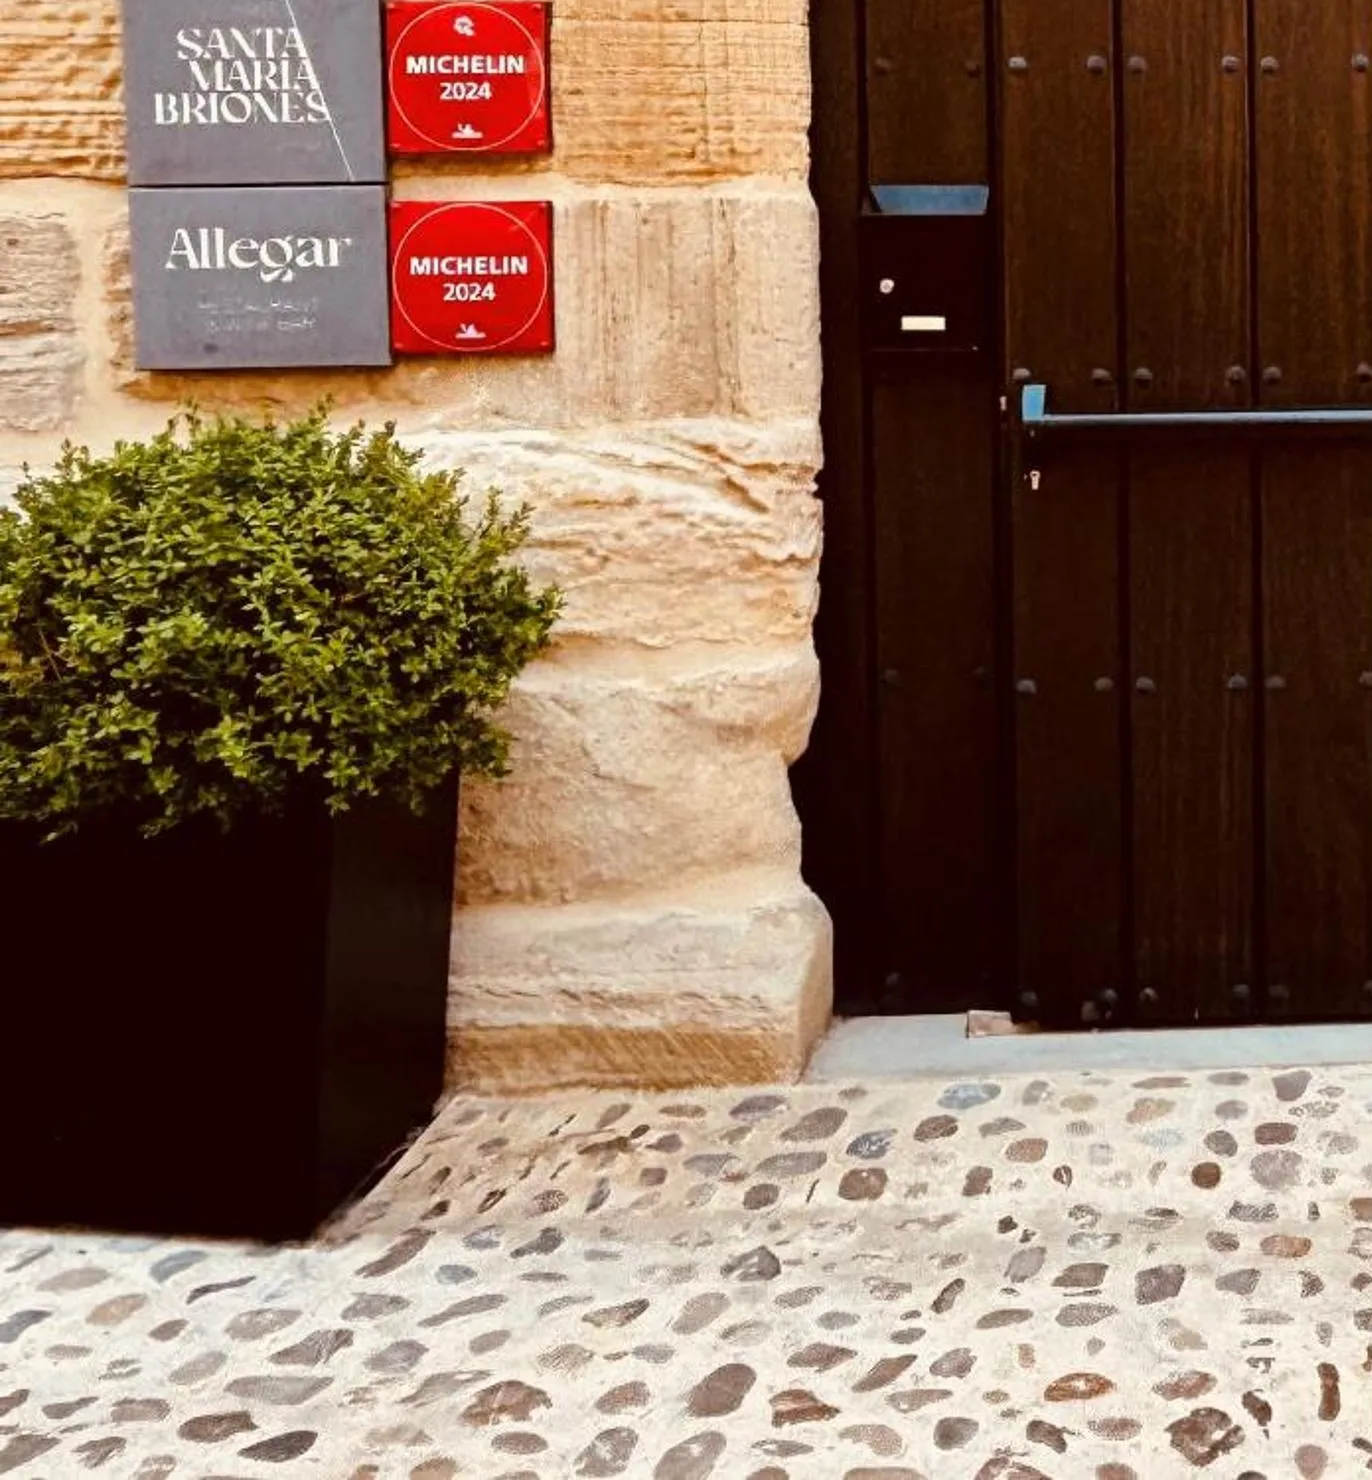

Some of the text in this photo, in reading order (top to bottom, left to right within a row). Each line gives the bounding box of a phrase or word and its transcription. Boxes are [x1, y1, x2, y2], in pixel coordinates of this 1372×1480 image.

[176, 27, 308, 60] SANTA
[188, 60, 320, 91] MARIA
[405, 54, 525, 74] MICHELIN
[439, 82, 492, 100] 2024
[154, 91, 330, 125] BRIONES
[165, 227, 351, 283] Allegar
[409, 256, 529, 276] MICHELIN
[442, 283, 496, 301] 2024
